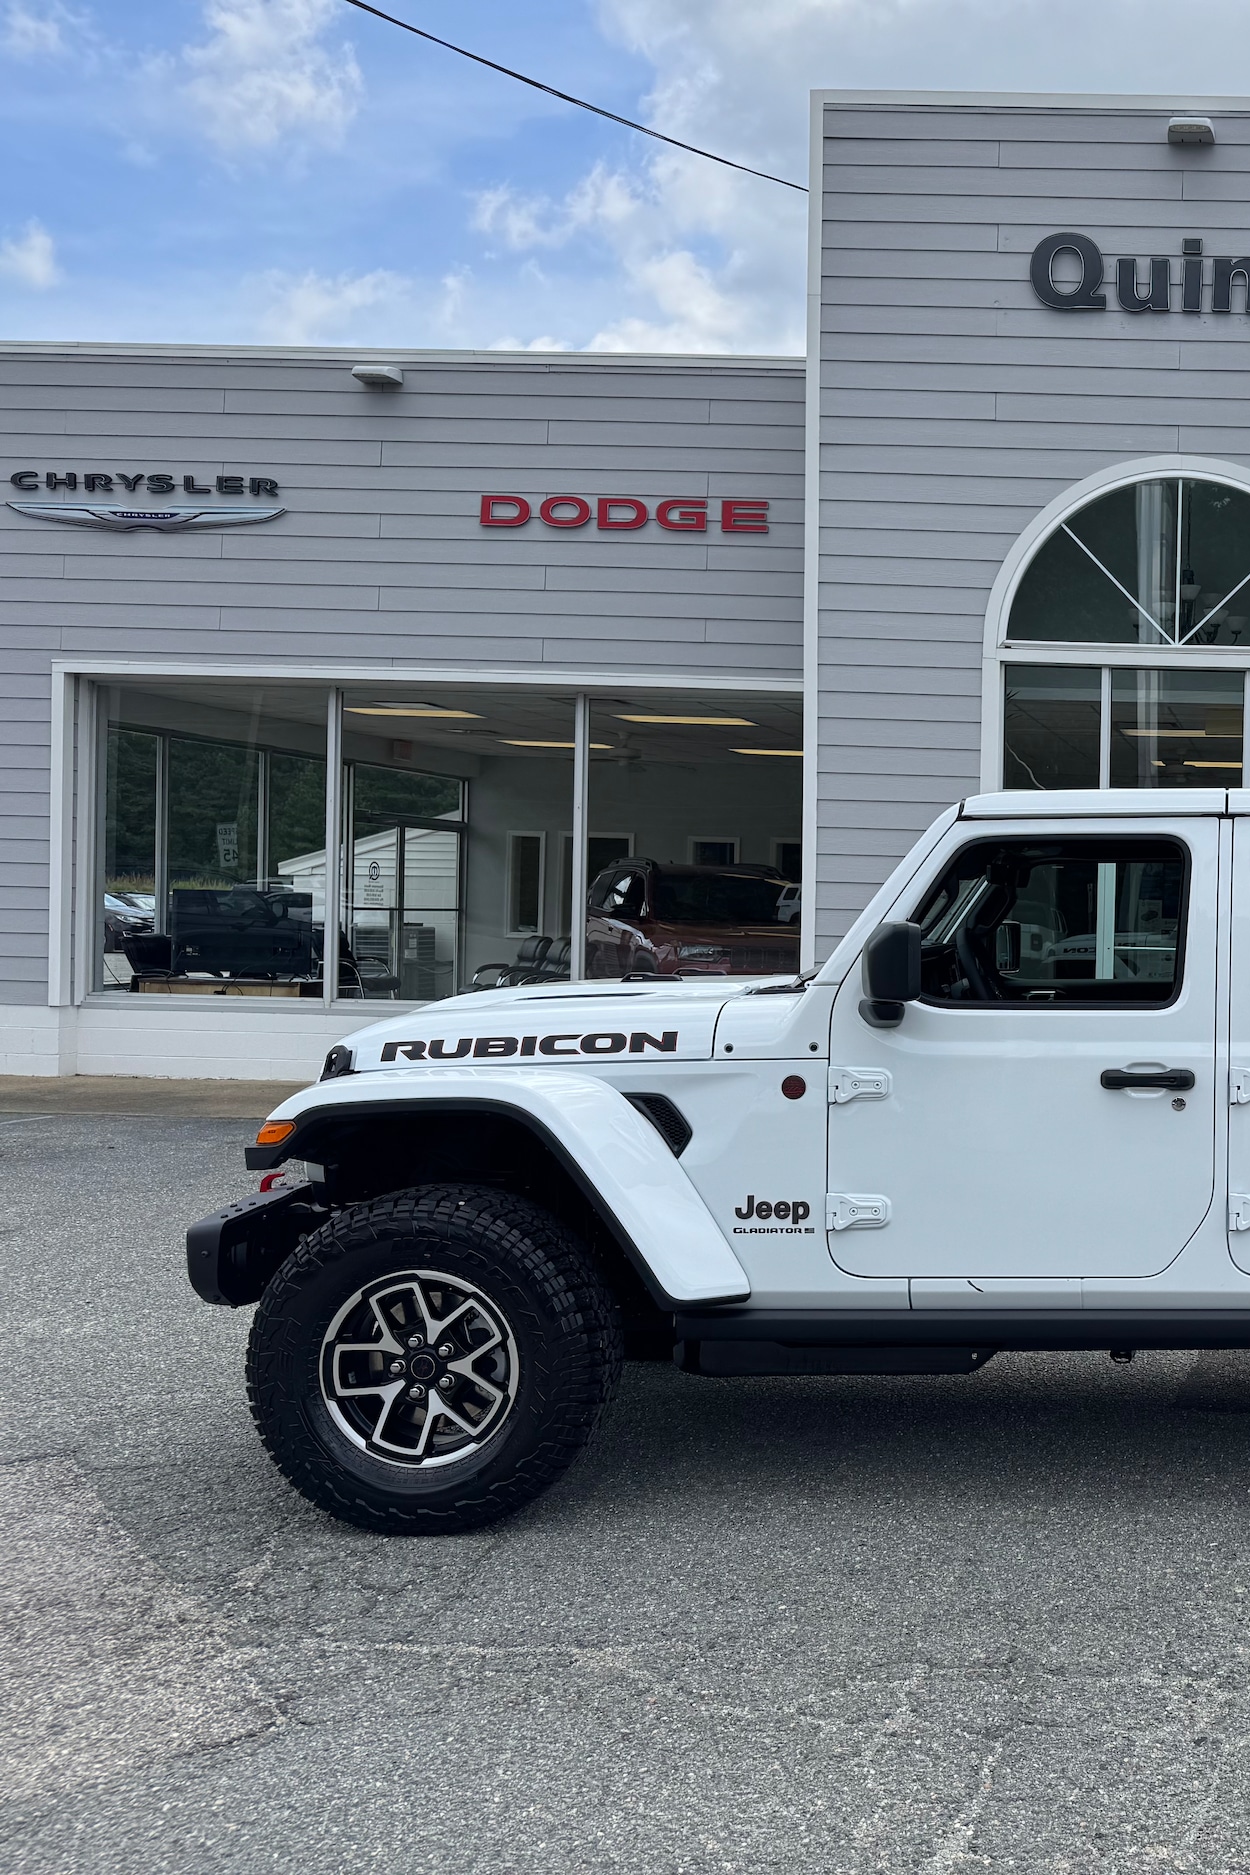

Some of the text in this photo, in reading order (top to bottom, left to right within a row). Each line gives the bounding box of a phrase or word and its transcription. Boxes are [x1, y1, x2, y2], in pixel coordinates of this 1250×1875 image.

[10, 471, 279, 496] CHRYSLER
[480, 495, 769, 533] DODGE
[380, 1031, 679, 1062] RUBICON
[735, 1195, 810, 1225] Jeep
